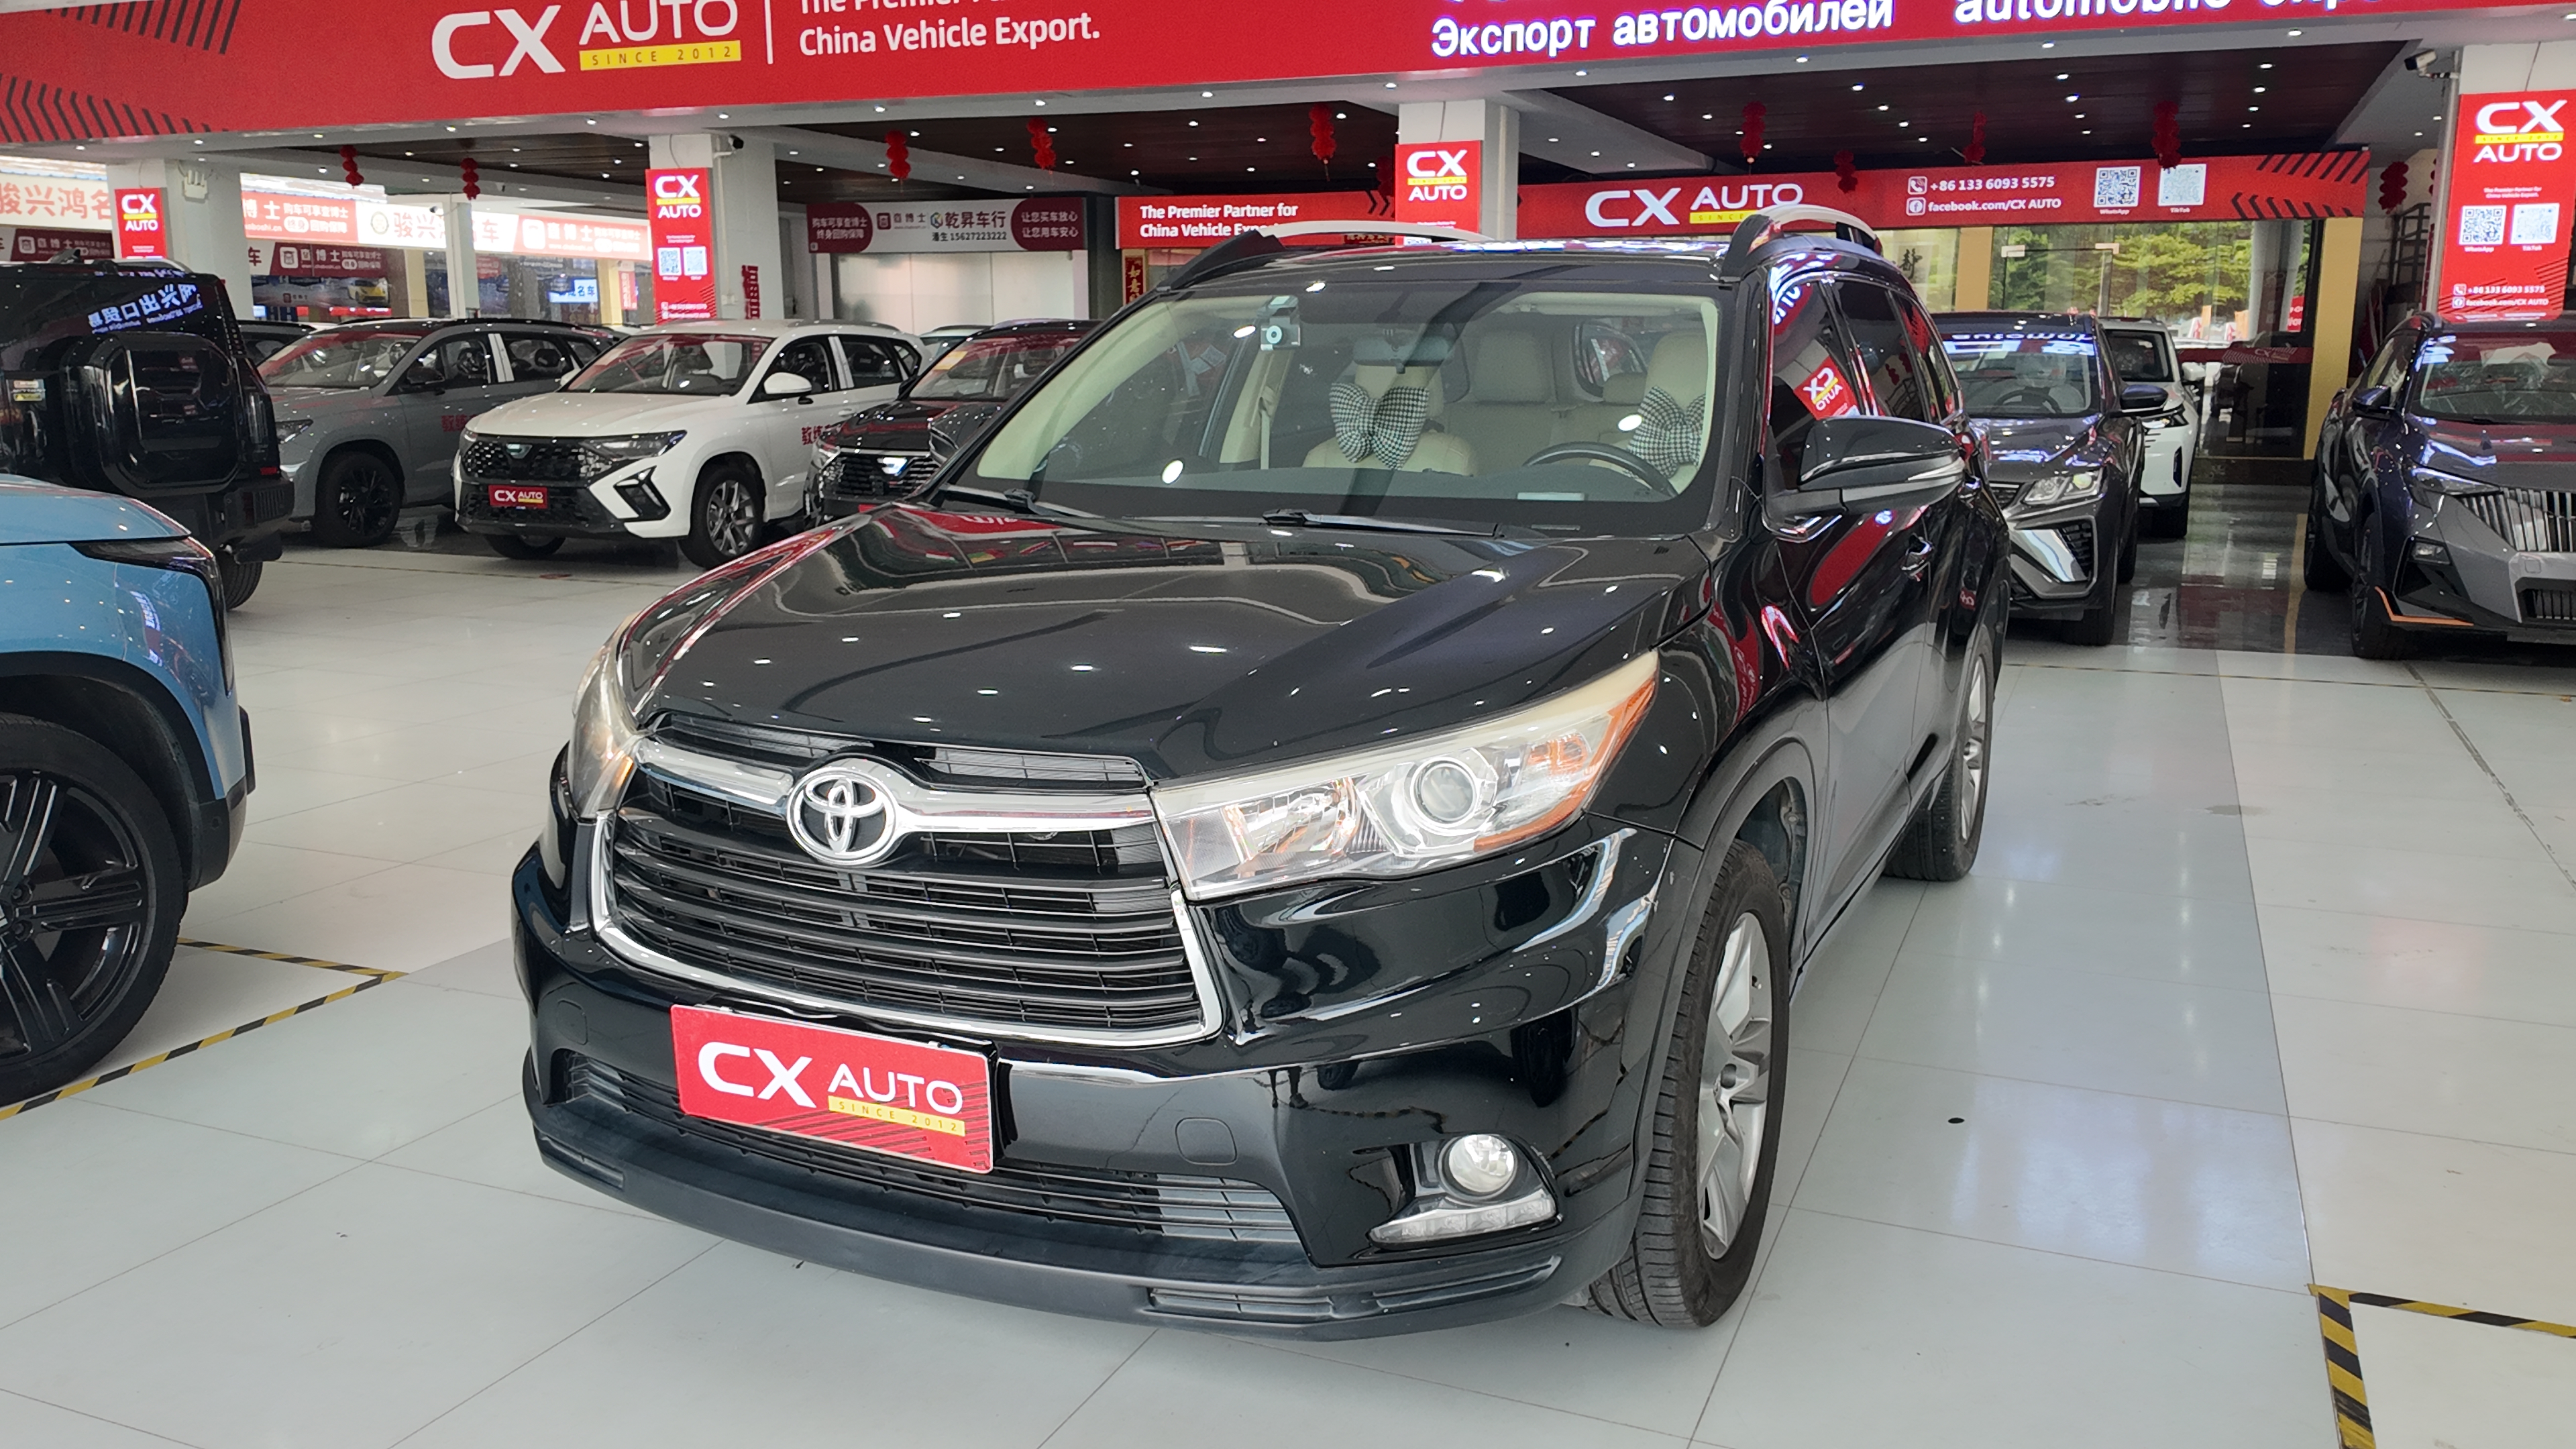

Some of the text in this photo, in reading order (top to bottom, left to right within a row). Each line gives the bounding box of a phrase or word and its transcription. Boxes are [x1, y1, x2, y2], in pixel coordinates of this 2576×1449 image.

[1953, 0, 2232, 23] automo
[799, 12, 1100, 56] China Vehicle Export.
[1431, 0, 1894, 57] Экспорт автомобилей
[431, 0, 739, 79] CX AUTO
[592, 46, 732, 66] SINCE 2012
[2475, 99, 2568, 134] CX
[2473, 142, 2563, 163] AUTO
[1406, 149, 1468, 177] CX
[655, 174, 700, 199] CX
[1408, 184, 1467, 201] AUTO
[1930, 176, 2055, 192] +86 133 6093 5575
[121, 193, 157, 213] CX
[657, 204, 702, 219] AUTO
[1140, 202, 1299, 219] The Premier Partner for
[1585, 182, 1803, 227] CX AUTO
[1927, 198, 2062, 212] facebook.com/CX AUTO
[125, 219, 159, 231] AUTO
[1021, 211, 1079, 223] 让您买车放心
[950, 231, 1008, 241] 15627223222
[1140, 223, 1179, 237] China
[1181, 222, 1232, 236] Vehicle
[2524, 285, 2545, 294] 5575
[494, 490, 543, 502] CX AUTO
[698, 1041, 963, 1116] CX AUTO
[838, 1100, 959, 1132] SINCE 2012
